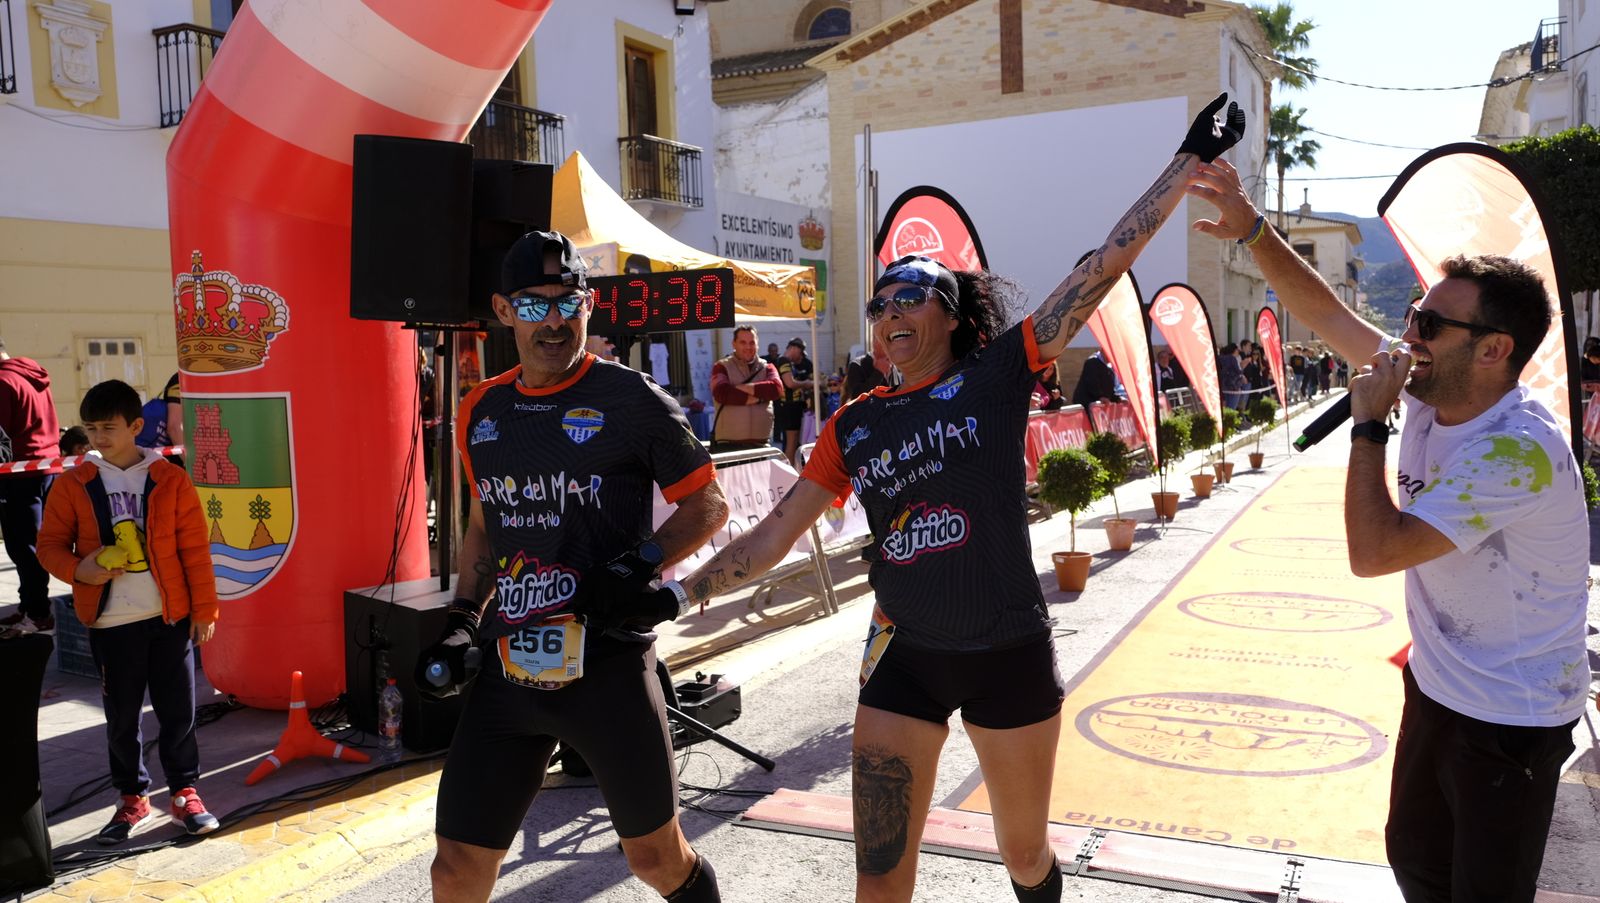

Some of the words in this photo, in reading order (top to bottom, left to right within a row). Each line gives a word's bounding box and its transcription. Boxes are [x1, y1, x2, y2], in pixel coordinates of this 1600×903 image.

[721, 213, 793, 240] EXCELENTÍSIMO
[725, 241, 793, 263] AYUNTAMIENTO
[593, 274, 722, 328] 43:38
[898, 432, 924, 461] del
[927, 416, 980, 458] MAR
[522, 474, 547, 502] del
[551, 470, 602, 515] MAR
[880, 477, 907, 500] todo
[908, 469, 917, 483] el
[500, 509, 523, 529] todo
[526, 512, 535, 527] el
[509, 628, 563, 655] 256
[1304, 716, 1347, 729] LA
[1064, 810, 1232, 842] Cantoria
[1246, 835, 1297, 851] de
